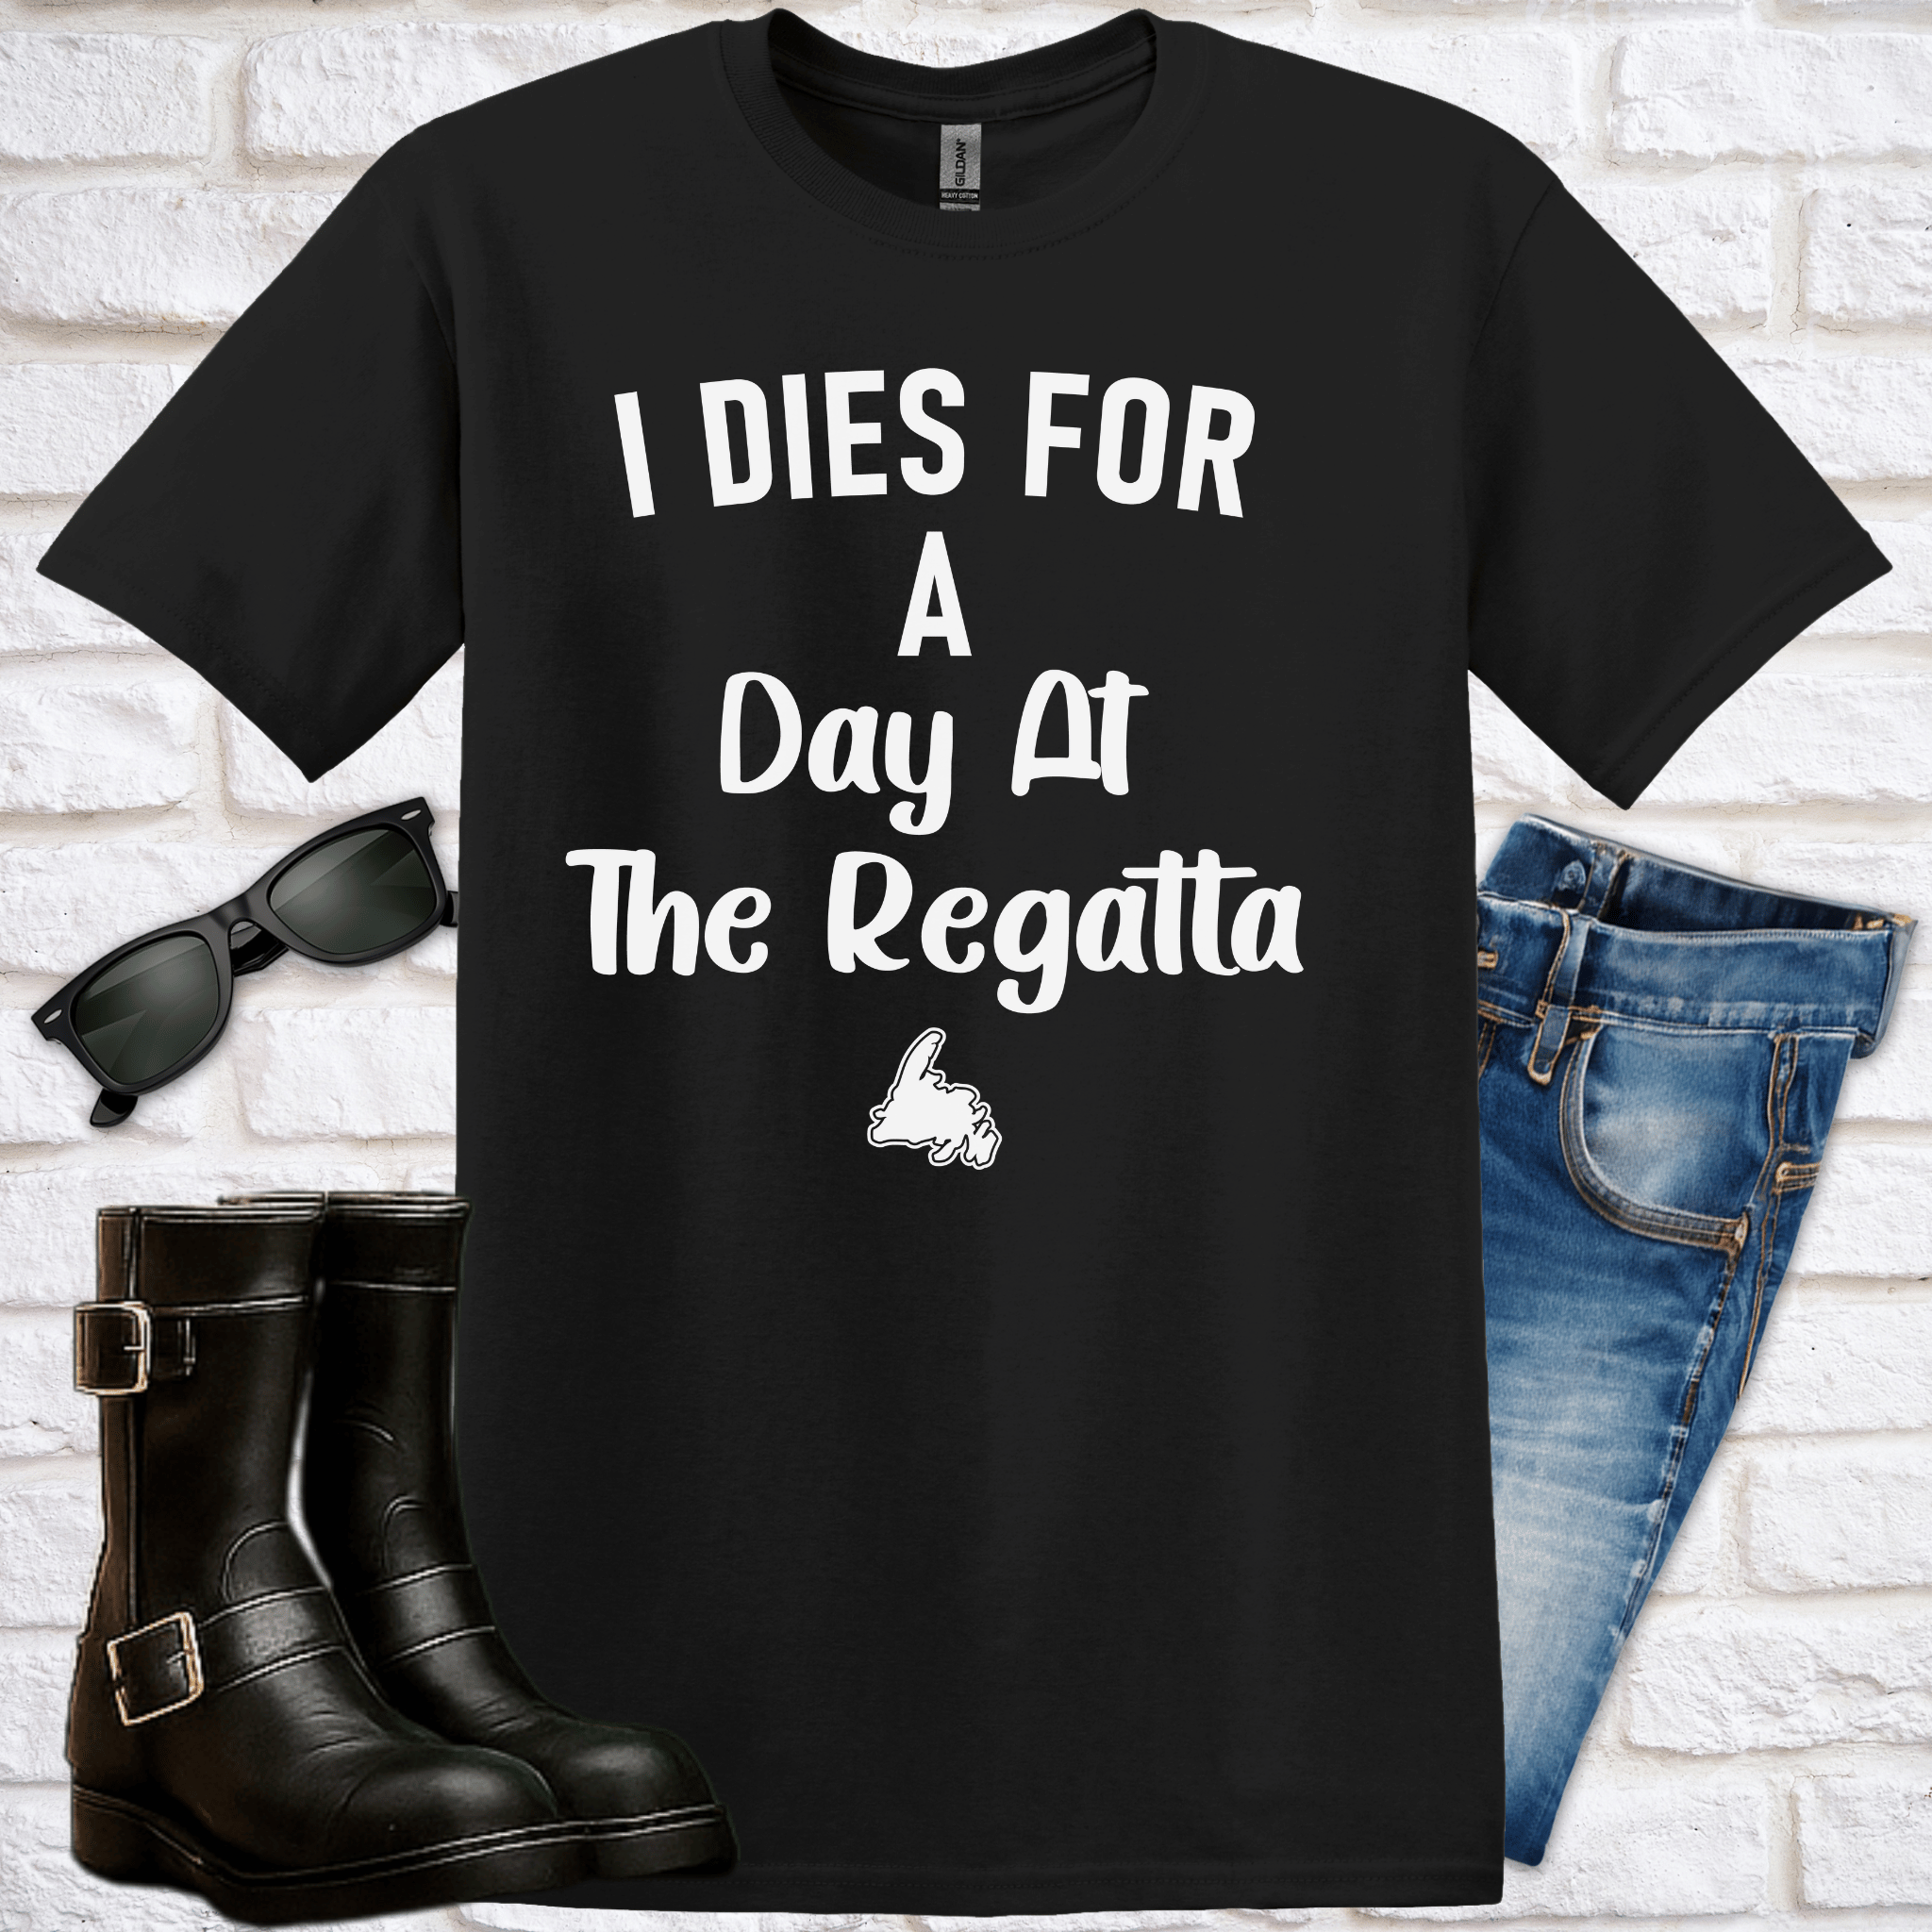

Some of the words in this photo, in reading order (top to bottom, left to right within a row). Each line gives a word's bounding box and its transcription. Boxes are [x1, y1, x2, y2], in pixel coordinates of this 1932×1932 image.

[955, 142, 966, 187] GILDAN
[613, 391, 656, 519] I
[699, 367, 965, 508] DIES
[1024, 371, 1256, 519] FOR
[896, 530, 973, 657] A
[720, 671, 954, 836] Day
[1010, 669, 1150, 797] At
[565, 848, 772, 976] The
[826, 848, 1305, 1014] Regatta
